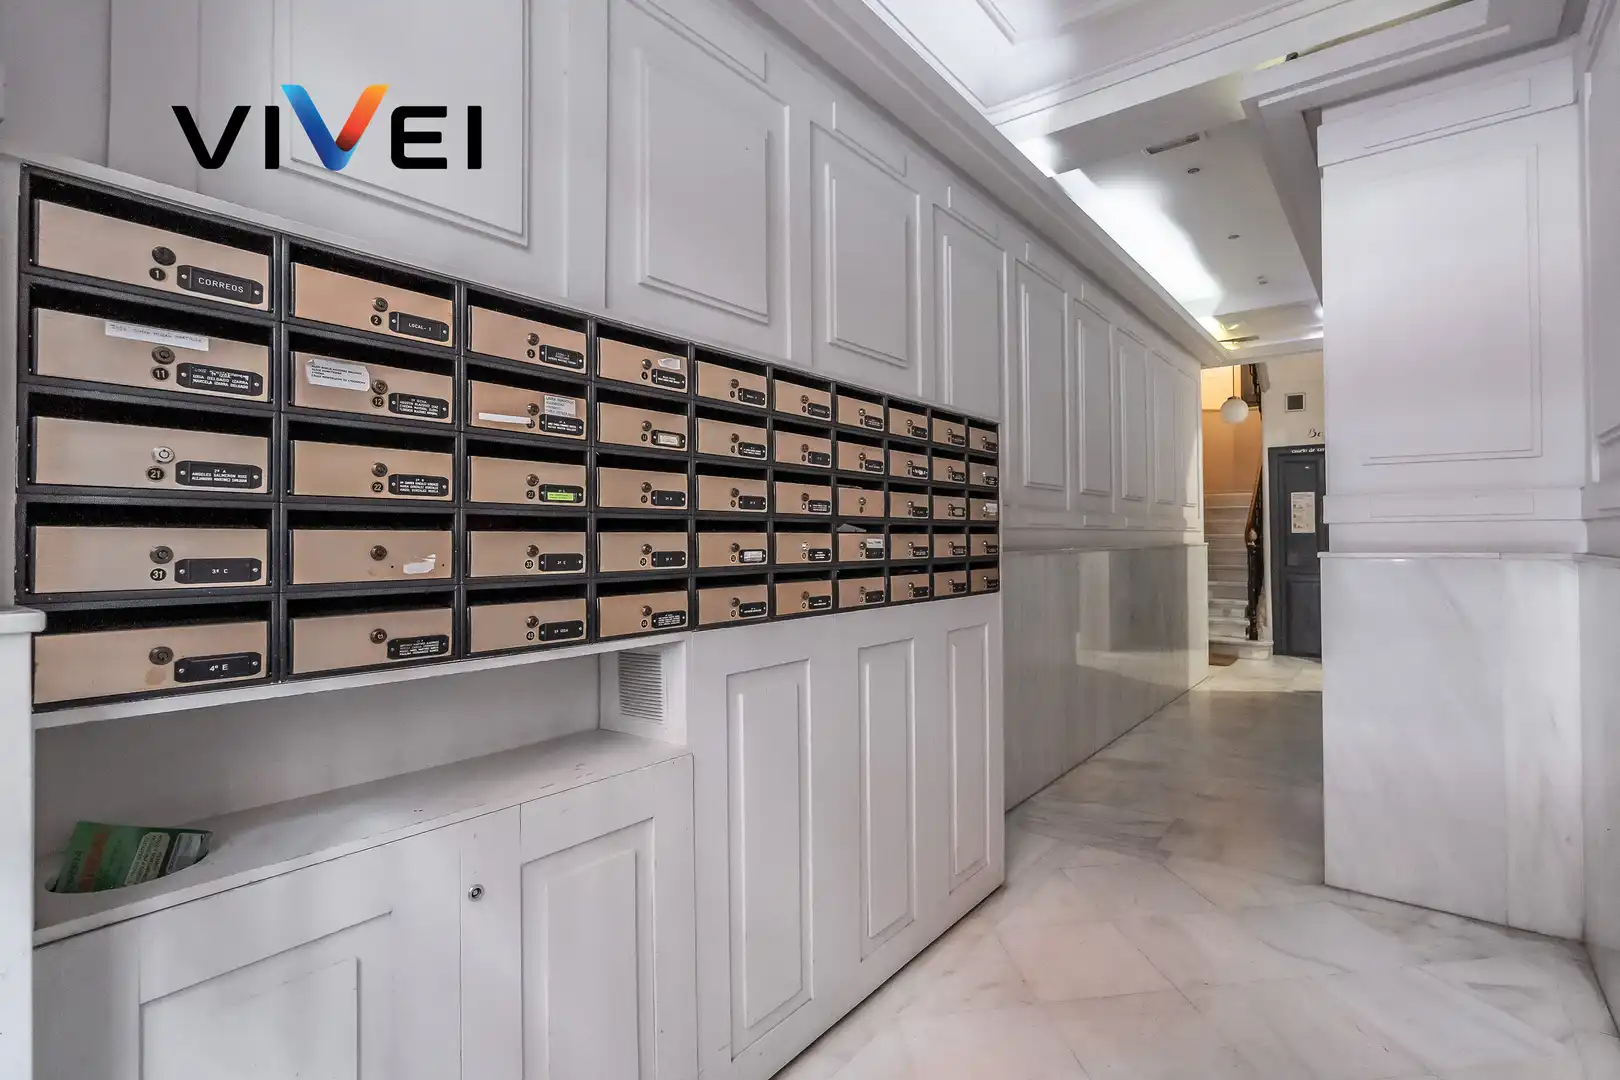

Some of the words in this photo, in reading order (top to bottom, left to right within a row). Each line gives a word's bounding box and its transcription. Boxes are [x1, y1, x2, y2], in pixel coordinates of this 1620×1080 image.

[154, 269, 160, 279] 1
[198, 277, 244, 293] CORREOS
[155, 370, 166, 379] 11
[150, 470, 160, 478] 21
[373, 483, 382, 491] 22
[152, 570, 164, 579] 31
[222, 663, 229, 671] E
